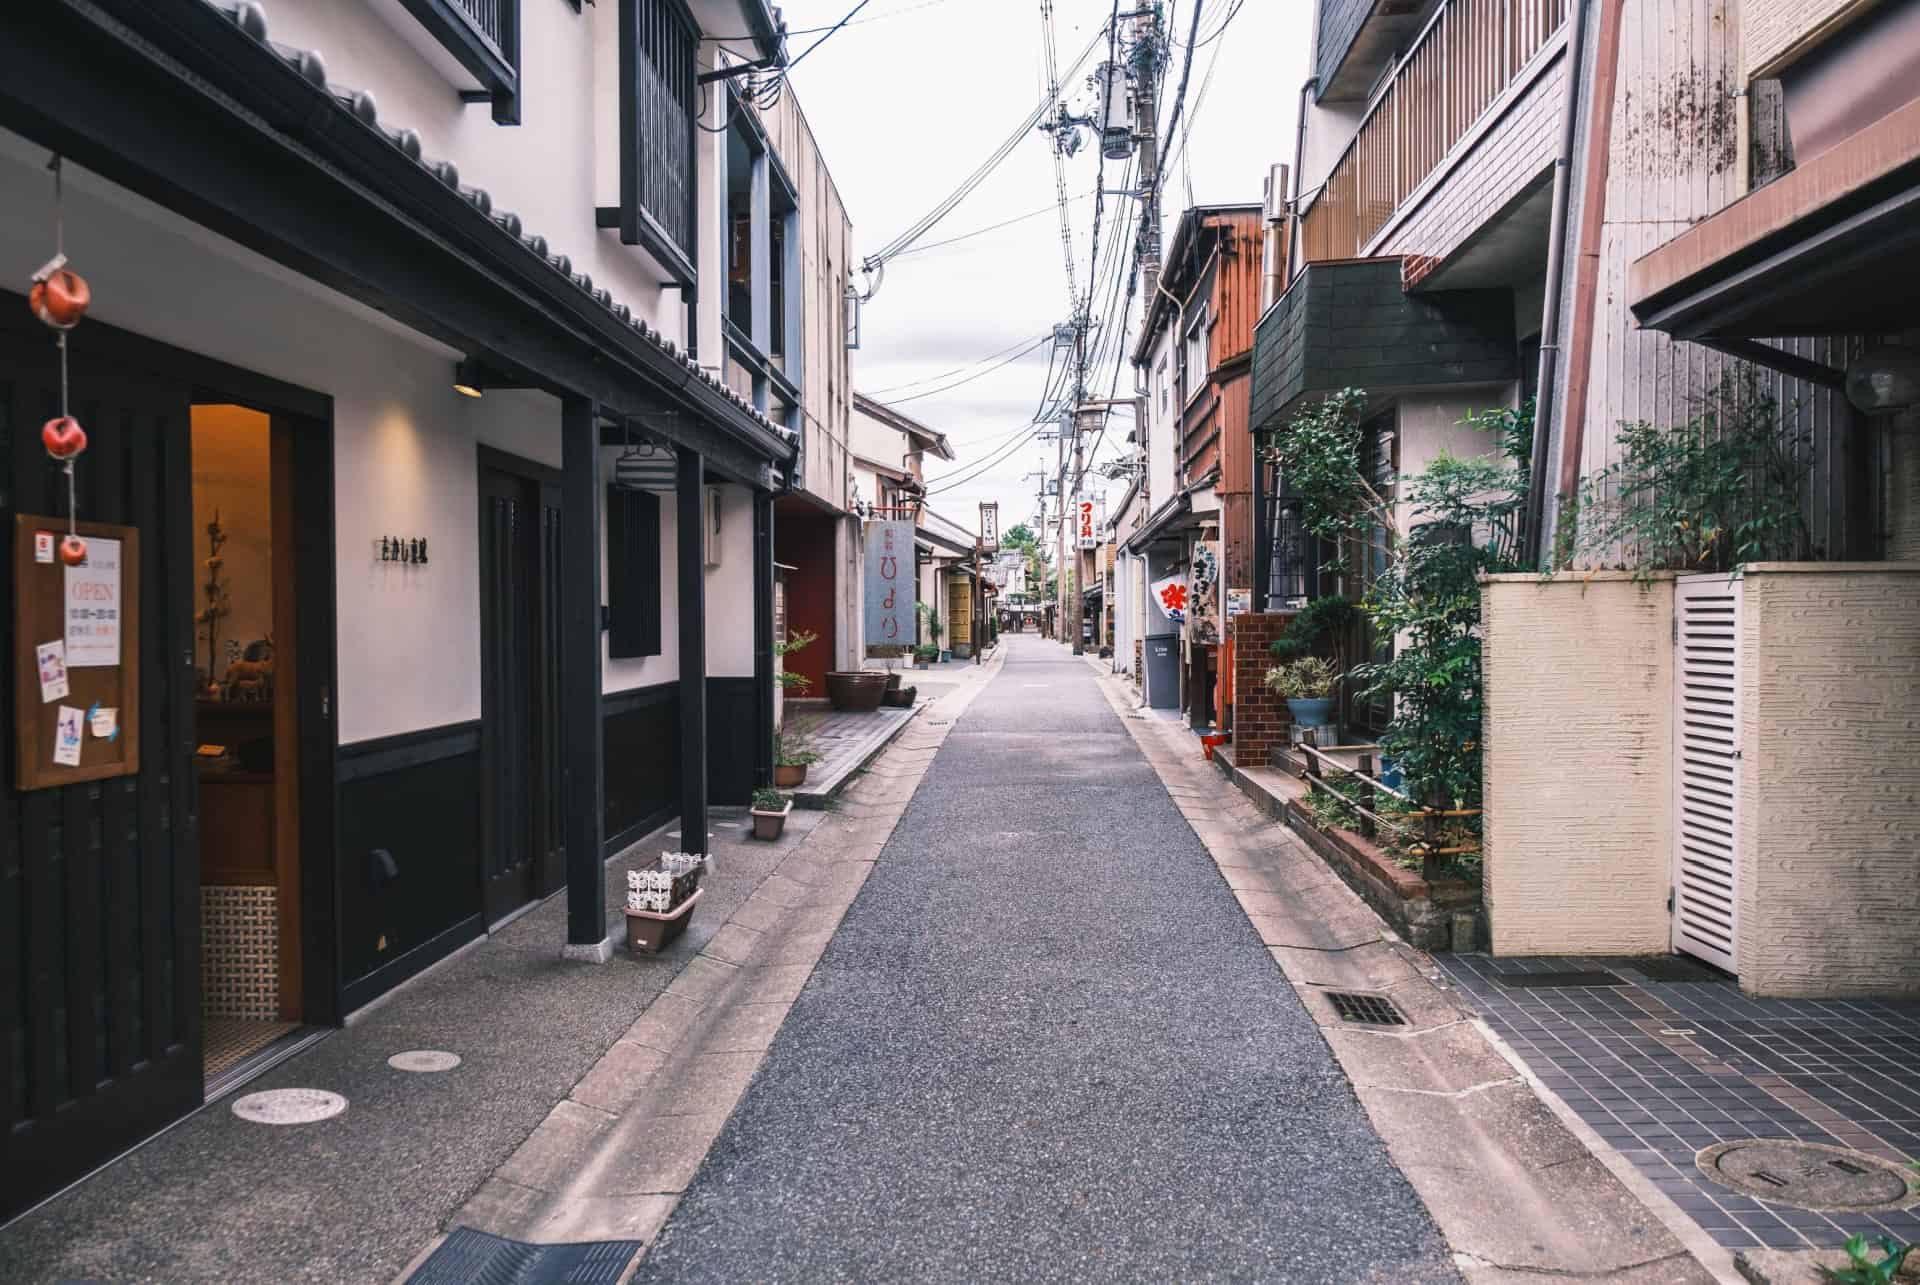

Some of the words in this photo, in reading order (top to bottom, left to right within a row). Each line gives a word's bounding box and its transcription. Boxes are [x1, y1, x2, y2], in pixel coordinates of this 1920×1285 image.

[1079, 502, 1093, 538] つり具
[71, 582, 113, 600] OPEN
[880, 557, 899, 638] ひより
